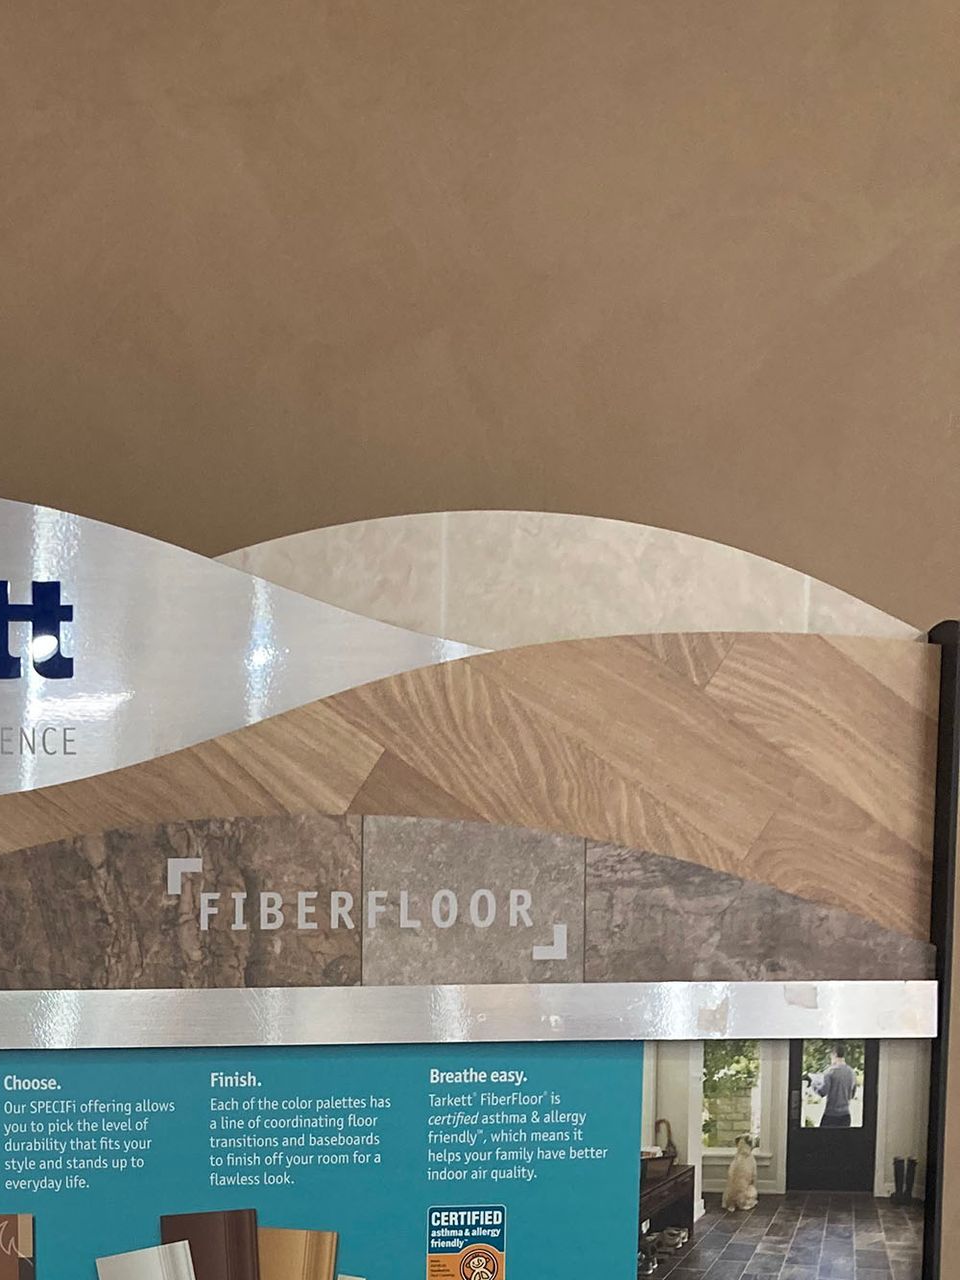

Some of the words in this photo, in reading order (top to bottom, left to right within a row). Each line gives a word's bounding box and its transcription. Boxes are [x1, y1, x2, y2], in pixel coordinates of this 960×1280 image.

[200, 889, 533, 931] FIBERFLOOR
[4, 1075, 61, 1090] Choose.
[211, 1072, 261, 1087] Finish.
[431, 1068, 487, 1083] Breathe
[491, 1071, 527, 1086] easy.
[211, 1098, 238, 1110] Each
[243, 1097, 255, 1110] of
[258, 1097, 278, 1110] the
[282, 1097, 312, 1109] color
[317, 1096, 366, 1112] palettes
[370, 1096, 391, 1108] has
[551, 1092, 560, 1104] is
[4, 1101, 26, 1114] Our
[30, 1101, 75, 1113] SPECIFi
[80, 1100, 131, 1115] offering
[136, 1099, 175, 1112] allows
[4, 1123, 26, 1136] you
[31, 1121, 44, 1132] to
[49, 1119, 73, 1135] pick
[77, 1119, 98, 1131] the
[102, 1118, 132, 1131] level
[136, 1118, 148, 1130] of
[210, 1120, 216, 1129] a
[221, 1117, 244, 1129] line
[248, 1116, 261, 1128] of
[264, 1115, 343, 1130] coordinating
[348, 1114, 377, 1126] floor
[428, 1112, 479, 1128] certified
[482, 1112, 526, 1124] asthma
[531, 1111, 540, 1123] &
[544, 1110, 586, 1125] allergy
[210, 1135, 278, 1148] transitions
[282, 1134, 304, 1146] and
[310, 1133, 379, 1145] baseboards
[491, 1129, 526, 1142] which
[531, 1132, 569, 1141] means
[573, 1128, 582, 1140] it
[5, 1138, 66, 1153] durability
[70, 1138, 96, 1150] that
[100, 1137, 120, 1149] fits
[124, 1140, 152, 1152] your
[210, 1155, 223, 1166] to
[227, 1153, 260, 1166] finish
[265, 1152, 283, 1165] off
[286, 1155, 313, 1168] your
[318, 1155, 348, 1164] room
[353, 1151, 371, 1163] for
[374, 1154, 380, 1163] a
[429, 1149, 461, 1164] helps
[465, 1152, 492, 1164] your
[496, 1147, 533, 1163] family
[537, 1147, 565, 1159] have
[570, 1147, 607, 1159] better
[5, 1157, 35, 1173] style
[39, 1157, 62, 1169] and
[67, 1156, 108, 1169] stands
[112, 1159, 127, 1171] up
[131, 1157, 144, 1167] to
[210, 1173, 260, 1185] flawless
[264, 1172, 294, 1184] look.
[428, 1168, 467, 1180] indoor
[471, 1167, 487, 1179] air
[491, 1166, 536, 1181] quality.
[5, 1176, 62, 1192] everyday
[66, 1175, 89, 1188] life.
[431, 1211, 502, 1226] CERTIFIED
[431, 1229, 463, 1237] asthma
[464, 1228, 470, 1236] &
[472, 1228, 501, 1237] allergy
